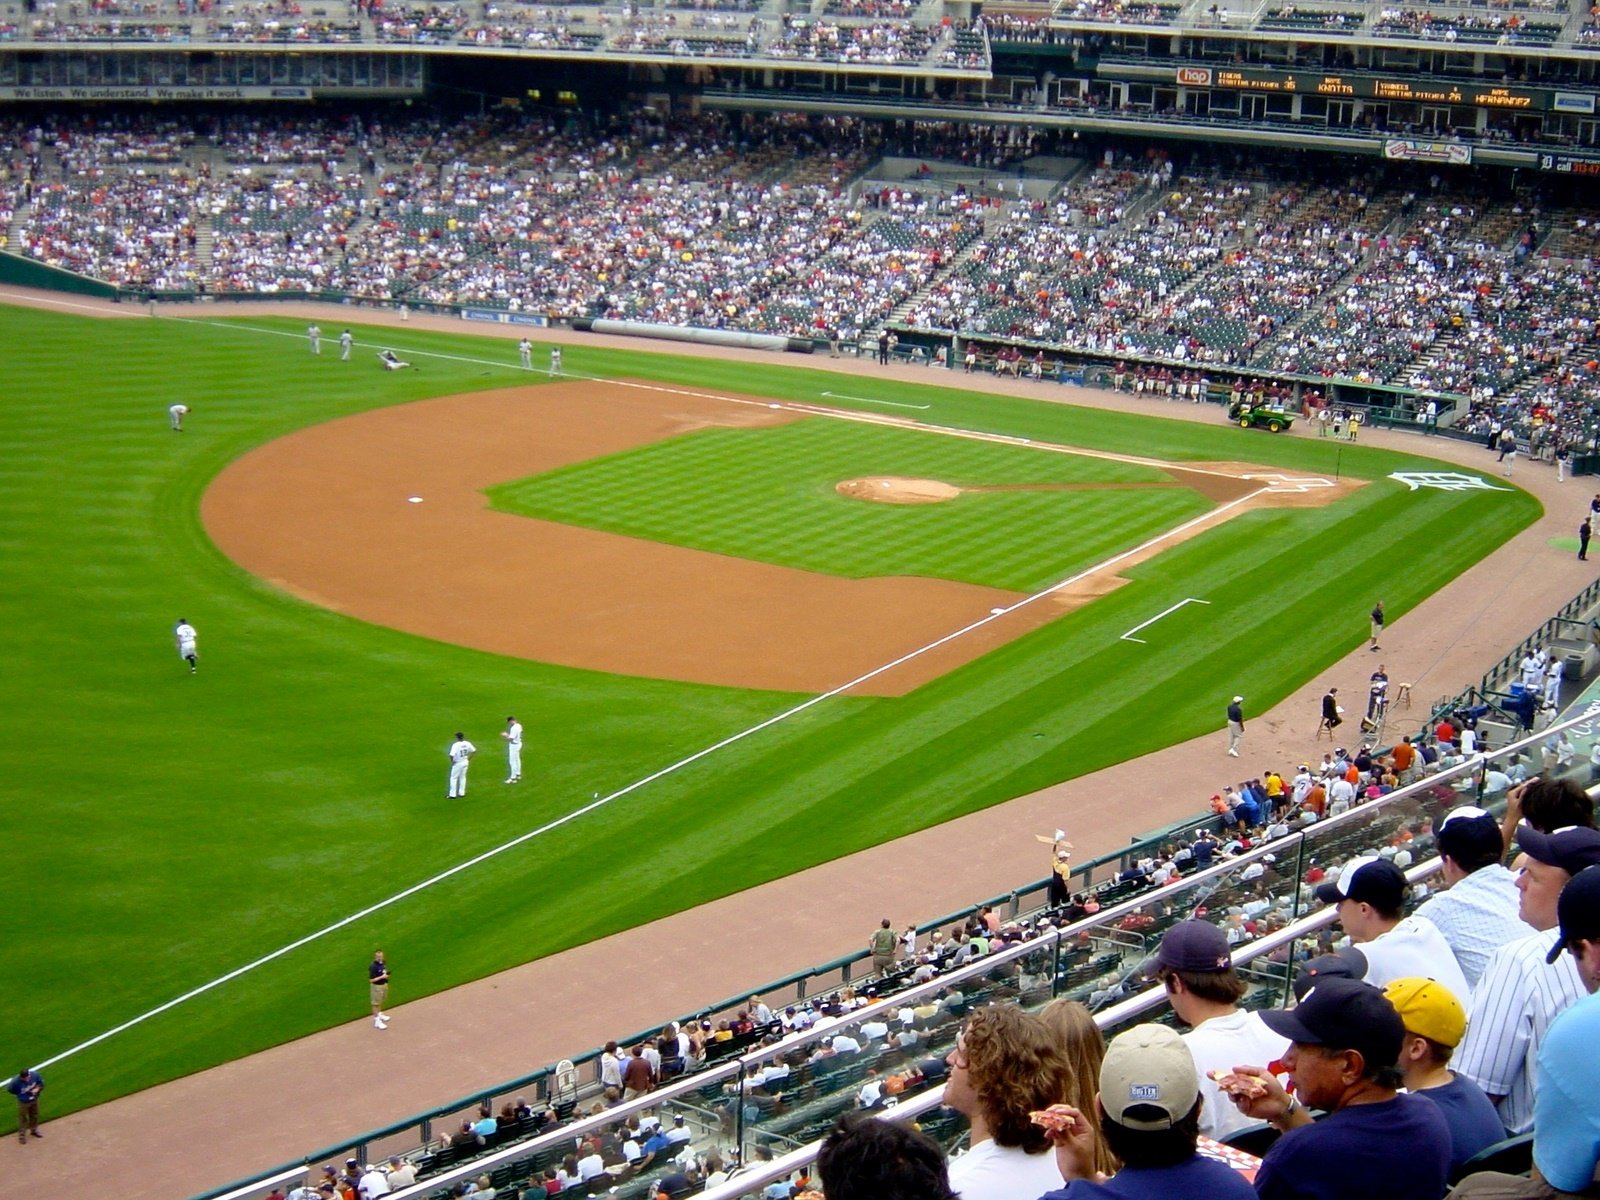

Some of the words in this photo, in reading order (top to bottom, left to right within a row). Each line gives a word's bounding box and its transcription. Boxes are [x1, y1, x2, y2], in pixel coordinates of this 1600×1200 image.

[1184, 68, 1206, 84] hap
[13, 88, 32, 98] We
[33, 88, 63, 98] listen.
[70, 88, 88, 98] We
[156, 89, 173, 99] We
[175, 89, 204, 99] make
[205, 88, 214, 98] it
[1557, 162, 1572, 172] call
